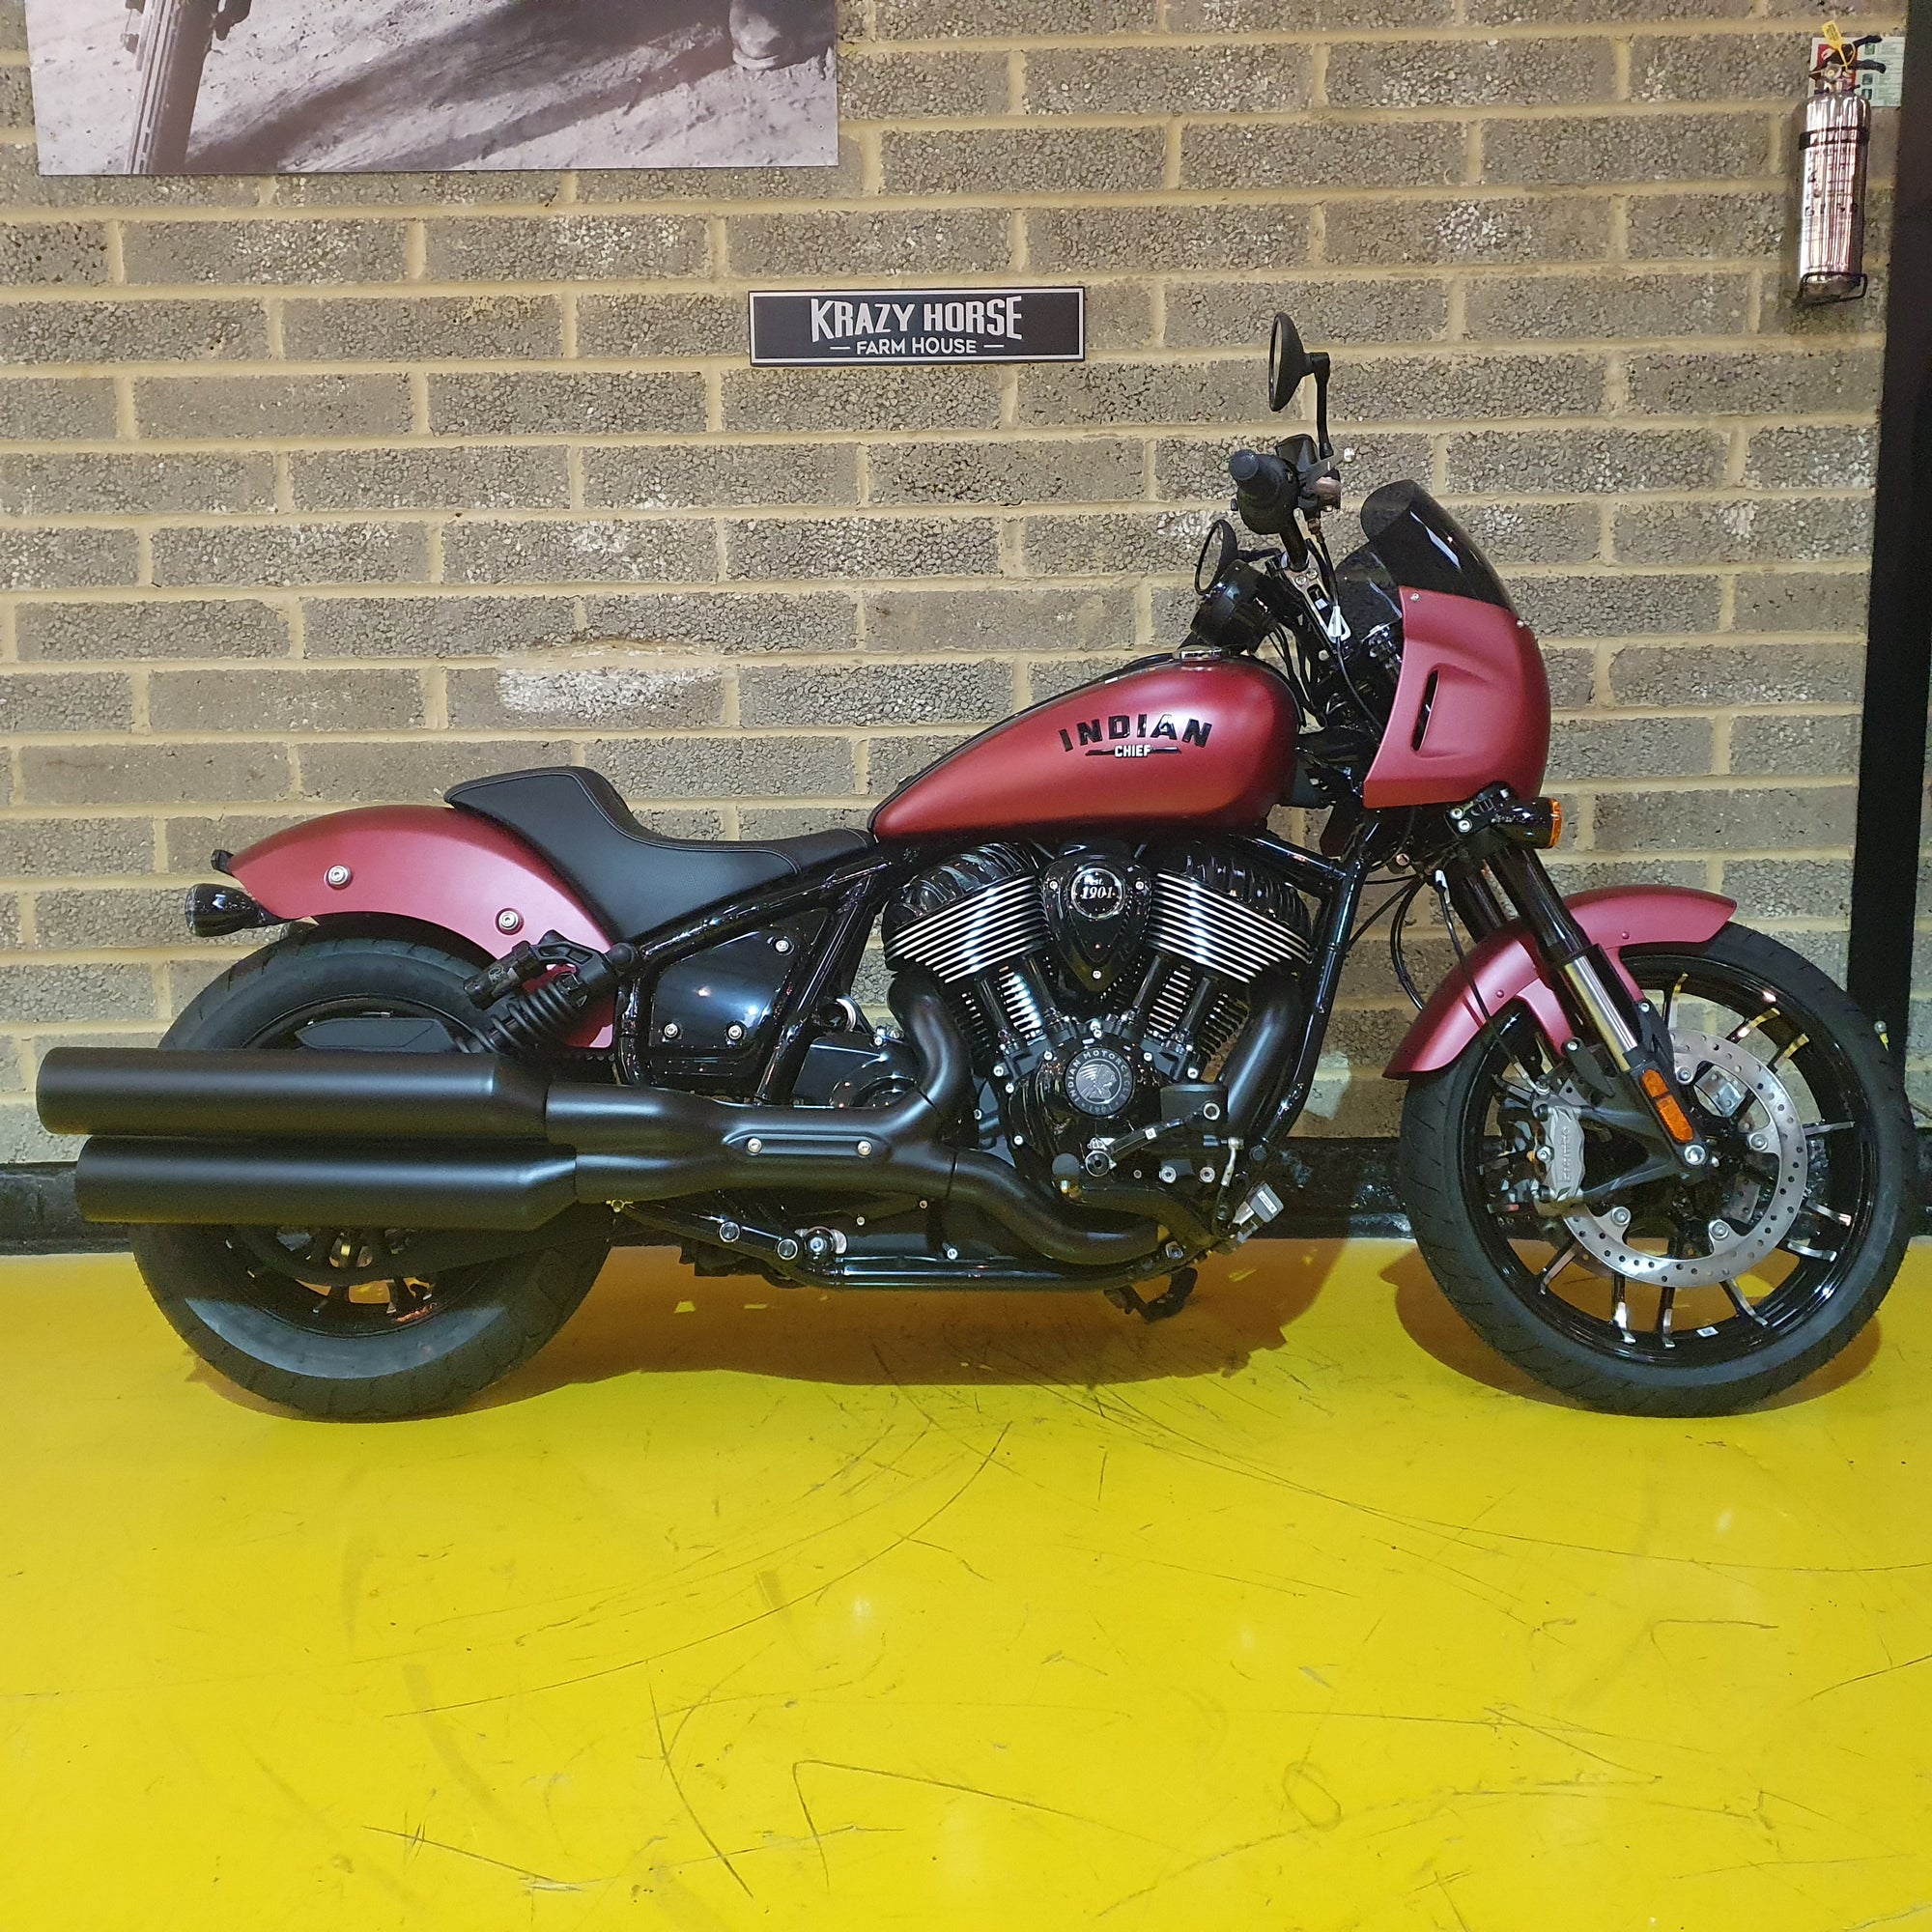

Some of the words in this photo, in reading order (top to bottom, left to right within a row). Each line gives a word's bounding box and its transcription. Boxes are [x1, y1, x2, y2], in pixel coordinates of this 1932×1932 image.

[810, 298, 916, 343] KRAZY
[923, 296, 1022, 340] HORSE
[856, 340, 906, 355] FARM
[912, 338, 977, 355] HOUSE
[1059, 714, 1212, 752] INDIAN
[1114, 744, 1151, 757] CHIEF
[1081, 886, 1113, 899] 1901
[1067, 1059, 1082, 1101] INDIAN
[1089, 1104, 1114, 1113] 1901
